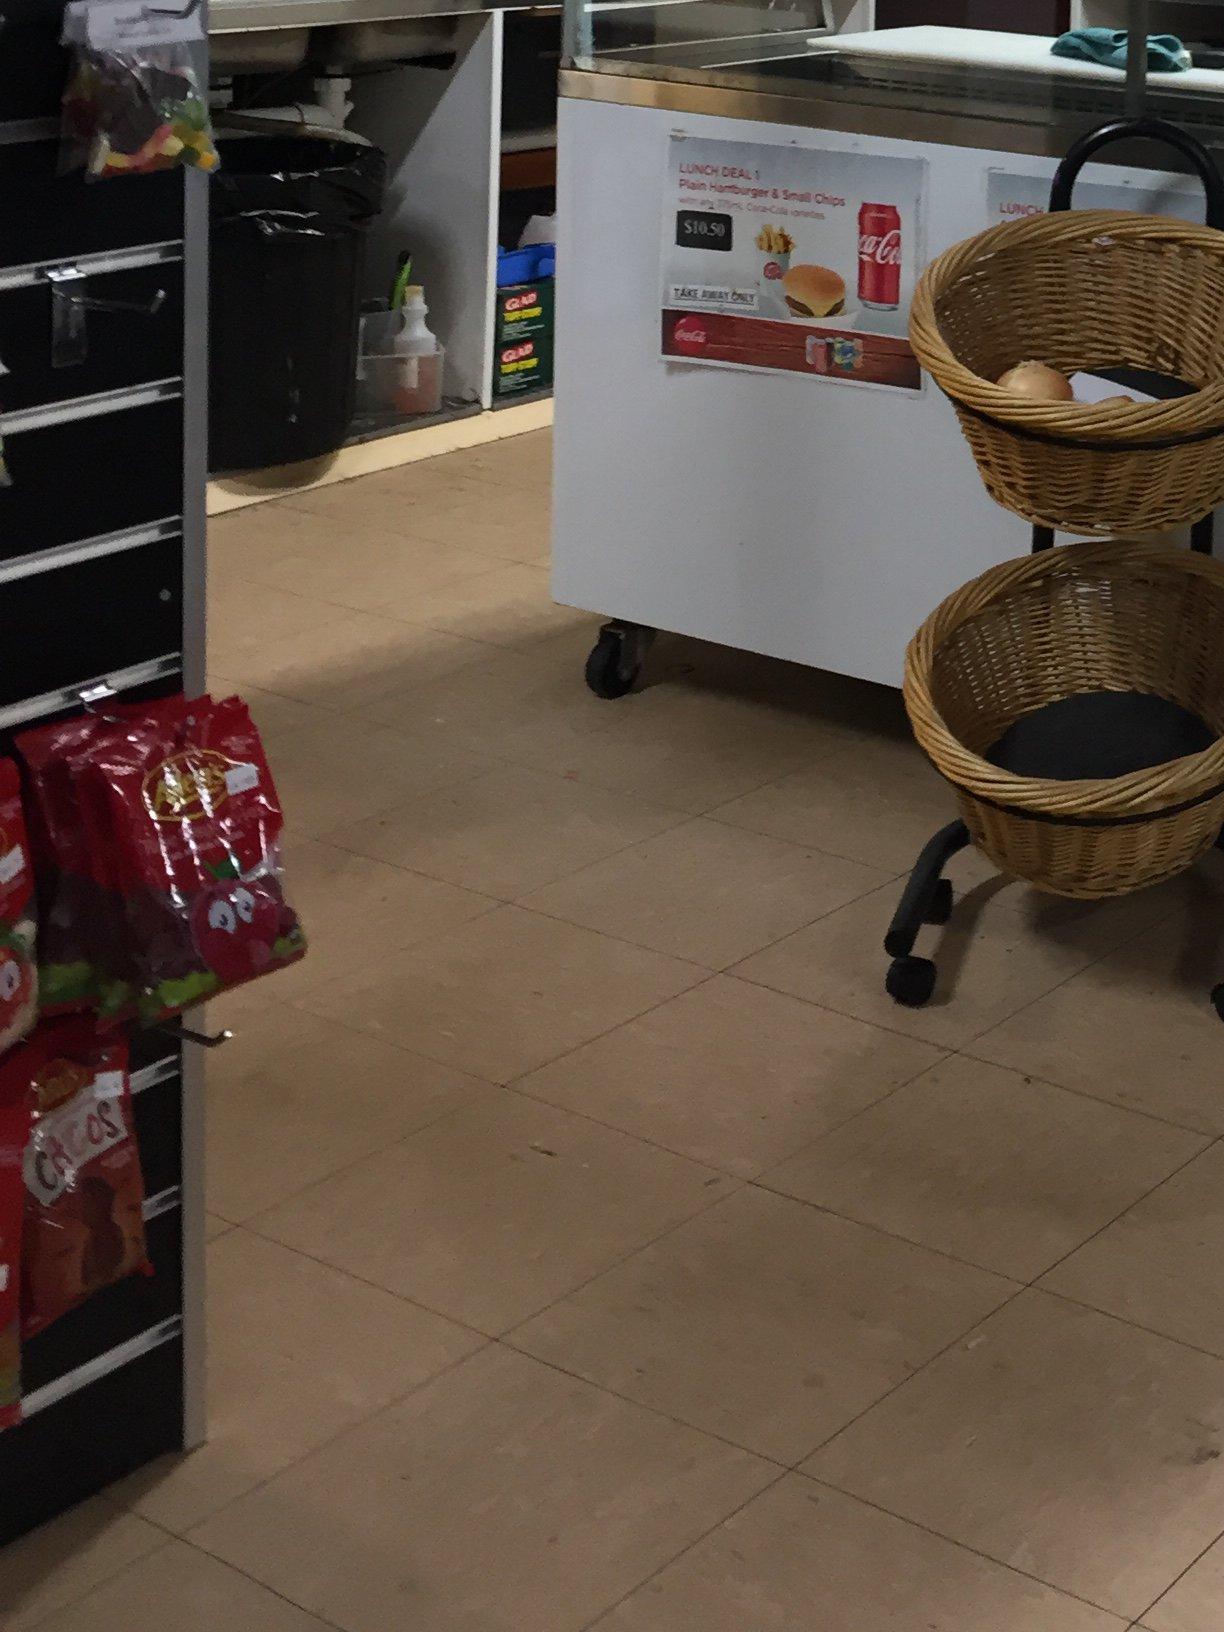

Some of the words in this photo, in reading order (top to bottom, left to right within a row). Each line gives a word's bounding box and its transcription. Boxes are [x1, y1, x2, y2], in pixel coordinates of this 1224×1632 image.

[679, 163, 718, 176] LUNCH
[721, 165, 752, 180] DEAL
[679, 179, 706, 191] Plain
[709, 183, 769, 199] Hamburger
[783, 189, 811, 203] Small
[815, 193, 846, 207] Chips
[684, 219, 726, 237] $10.50
